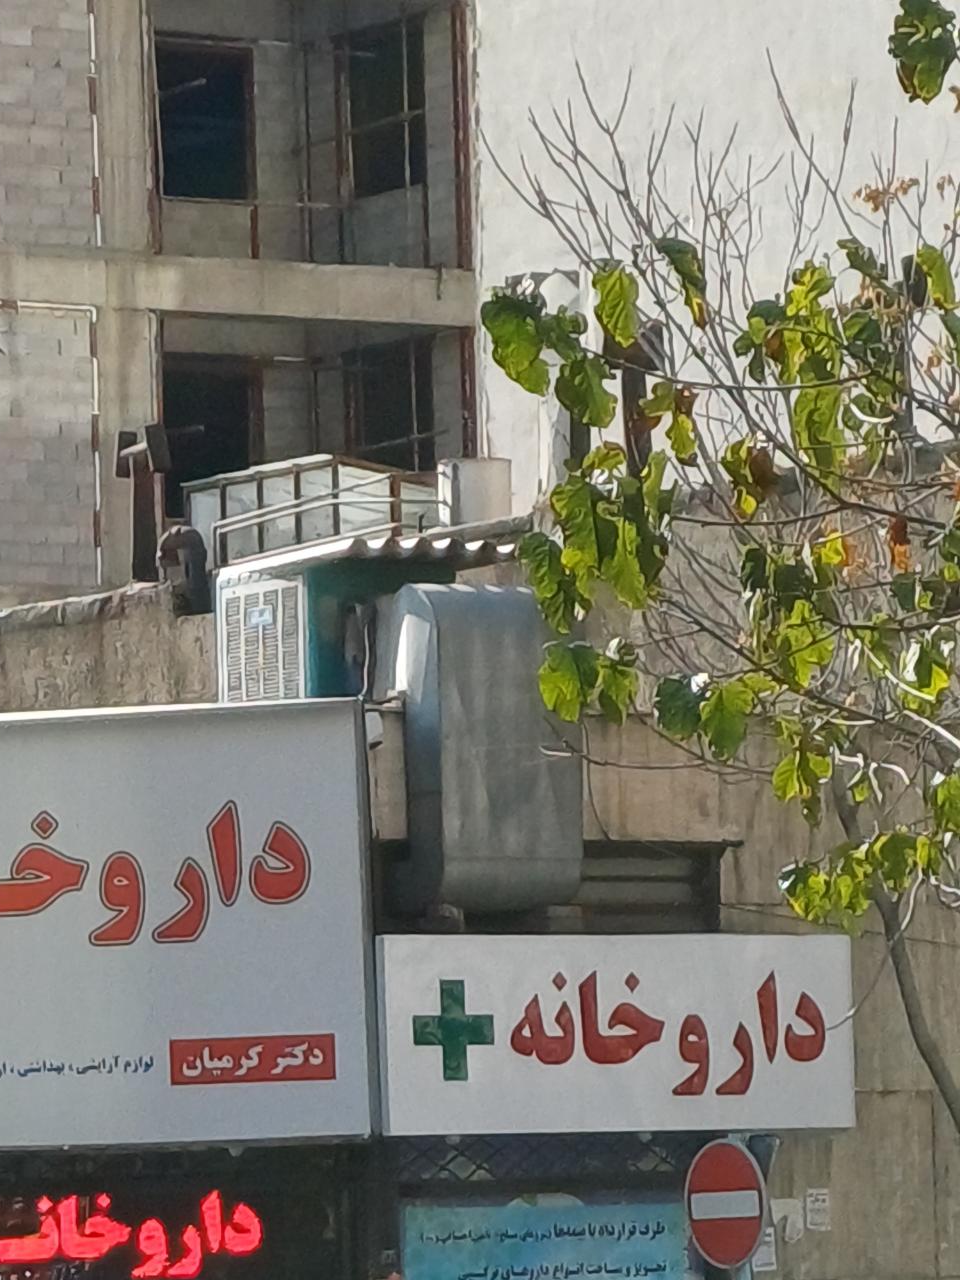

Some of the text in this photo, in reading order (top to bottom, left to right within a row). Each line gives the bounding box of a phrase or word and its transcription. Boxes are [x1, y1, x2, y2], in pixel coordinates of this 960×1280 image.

[510, 969, 826, 1096] داروخانه
[123, 1055, 154, 1073] لوازم
[182, 1042, 324, 1077] دکتر کرمیان
